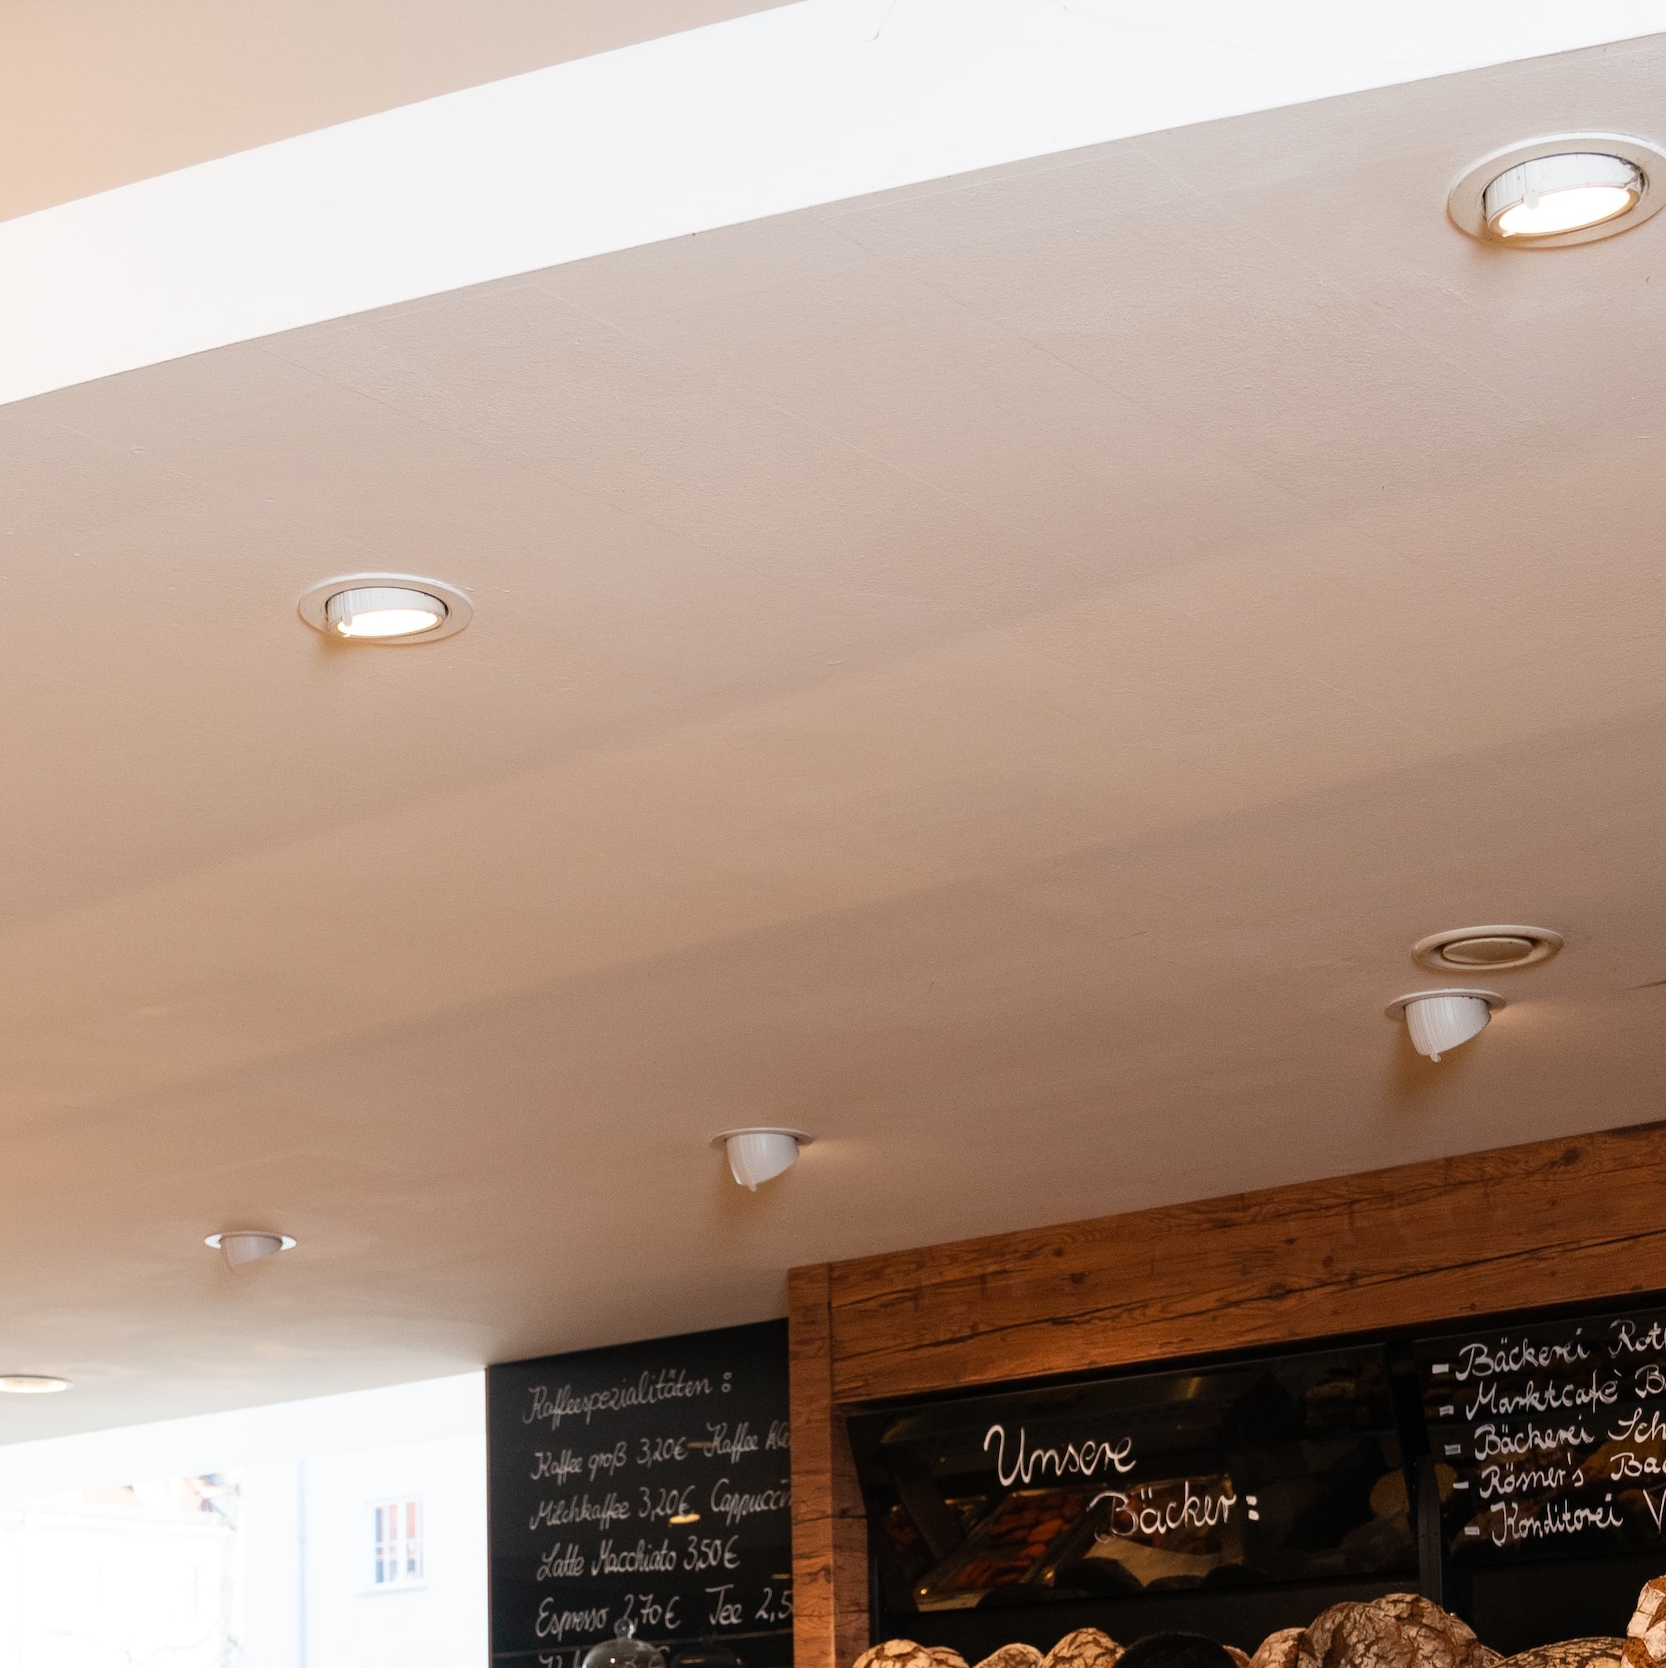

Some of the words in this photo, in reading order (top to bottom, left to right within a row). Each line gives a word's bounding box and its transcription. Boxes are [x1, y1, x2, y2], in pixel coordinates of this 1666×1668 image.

[1455, 1328, 1589, 1381] Bäckerei
[530, 1448, 582, 1486] Kaffee
[588, 1442, 627, 1482] groß
[704, 1421, 758, 1464] Kaffee
[984, 1424, 1136, 1487] Unsere
[1475, 1414, 1595, 1459] Bäckerei
[529, 1492, 631, 1531] Milchkaffee
[1491, 1493, 1623, 1547] Konditorei
[536, 1542, 584, 1581] Latte
[591, 1538, 677, 1576] Macchiato
[535, 1597, 610, 1641] Espresso
[705, 1584, 743, 1626] Tee
